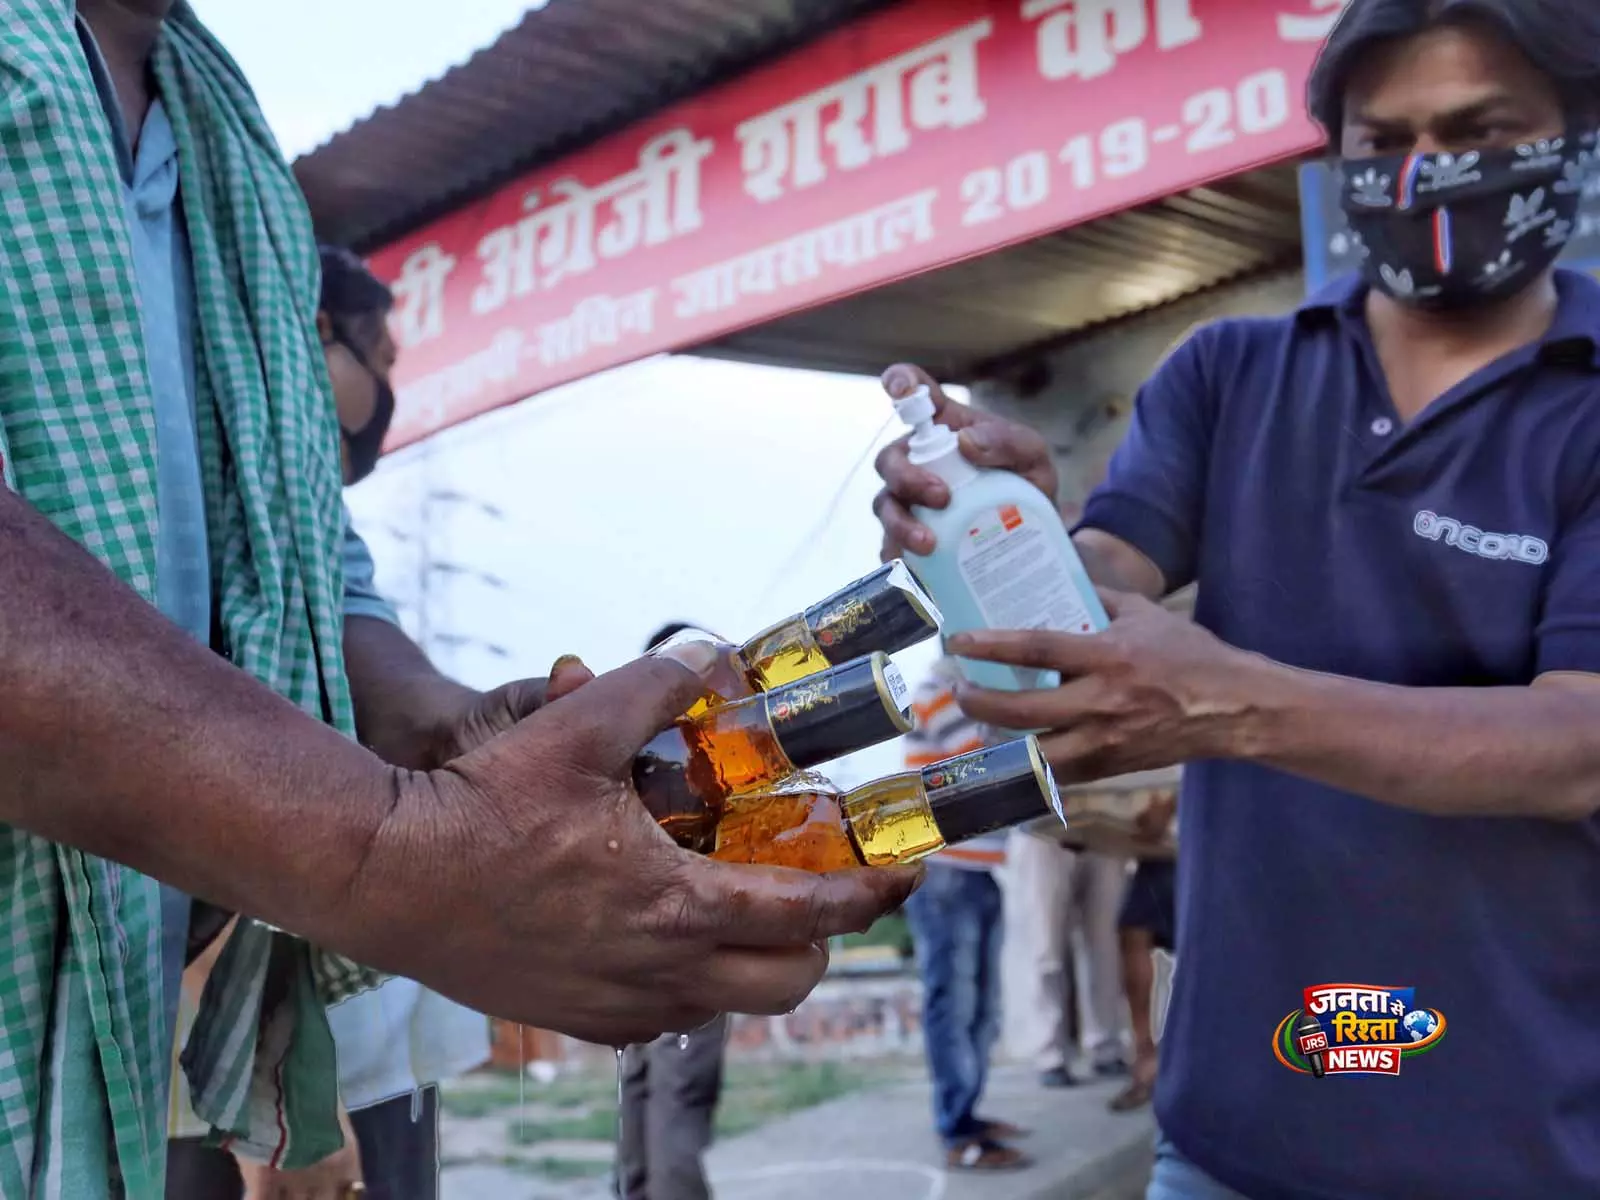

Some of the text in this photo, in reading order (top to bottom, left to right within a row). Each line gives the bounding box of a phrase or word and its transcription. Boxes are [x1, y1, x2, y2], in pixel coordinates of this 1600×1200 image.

[471, 128, 714, 316] अंग्रेजी
[735, 18, 993, 203] शराब
[961, 68, 1289, 227] 2019-20
